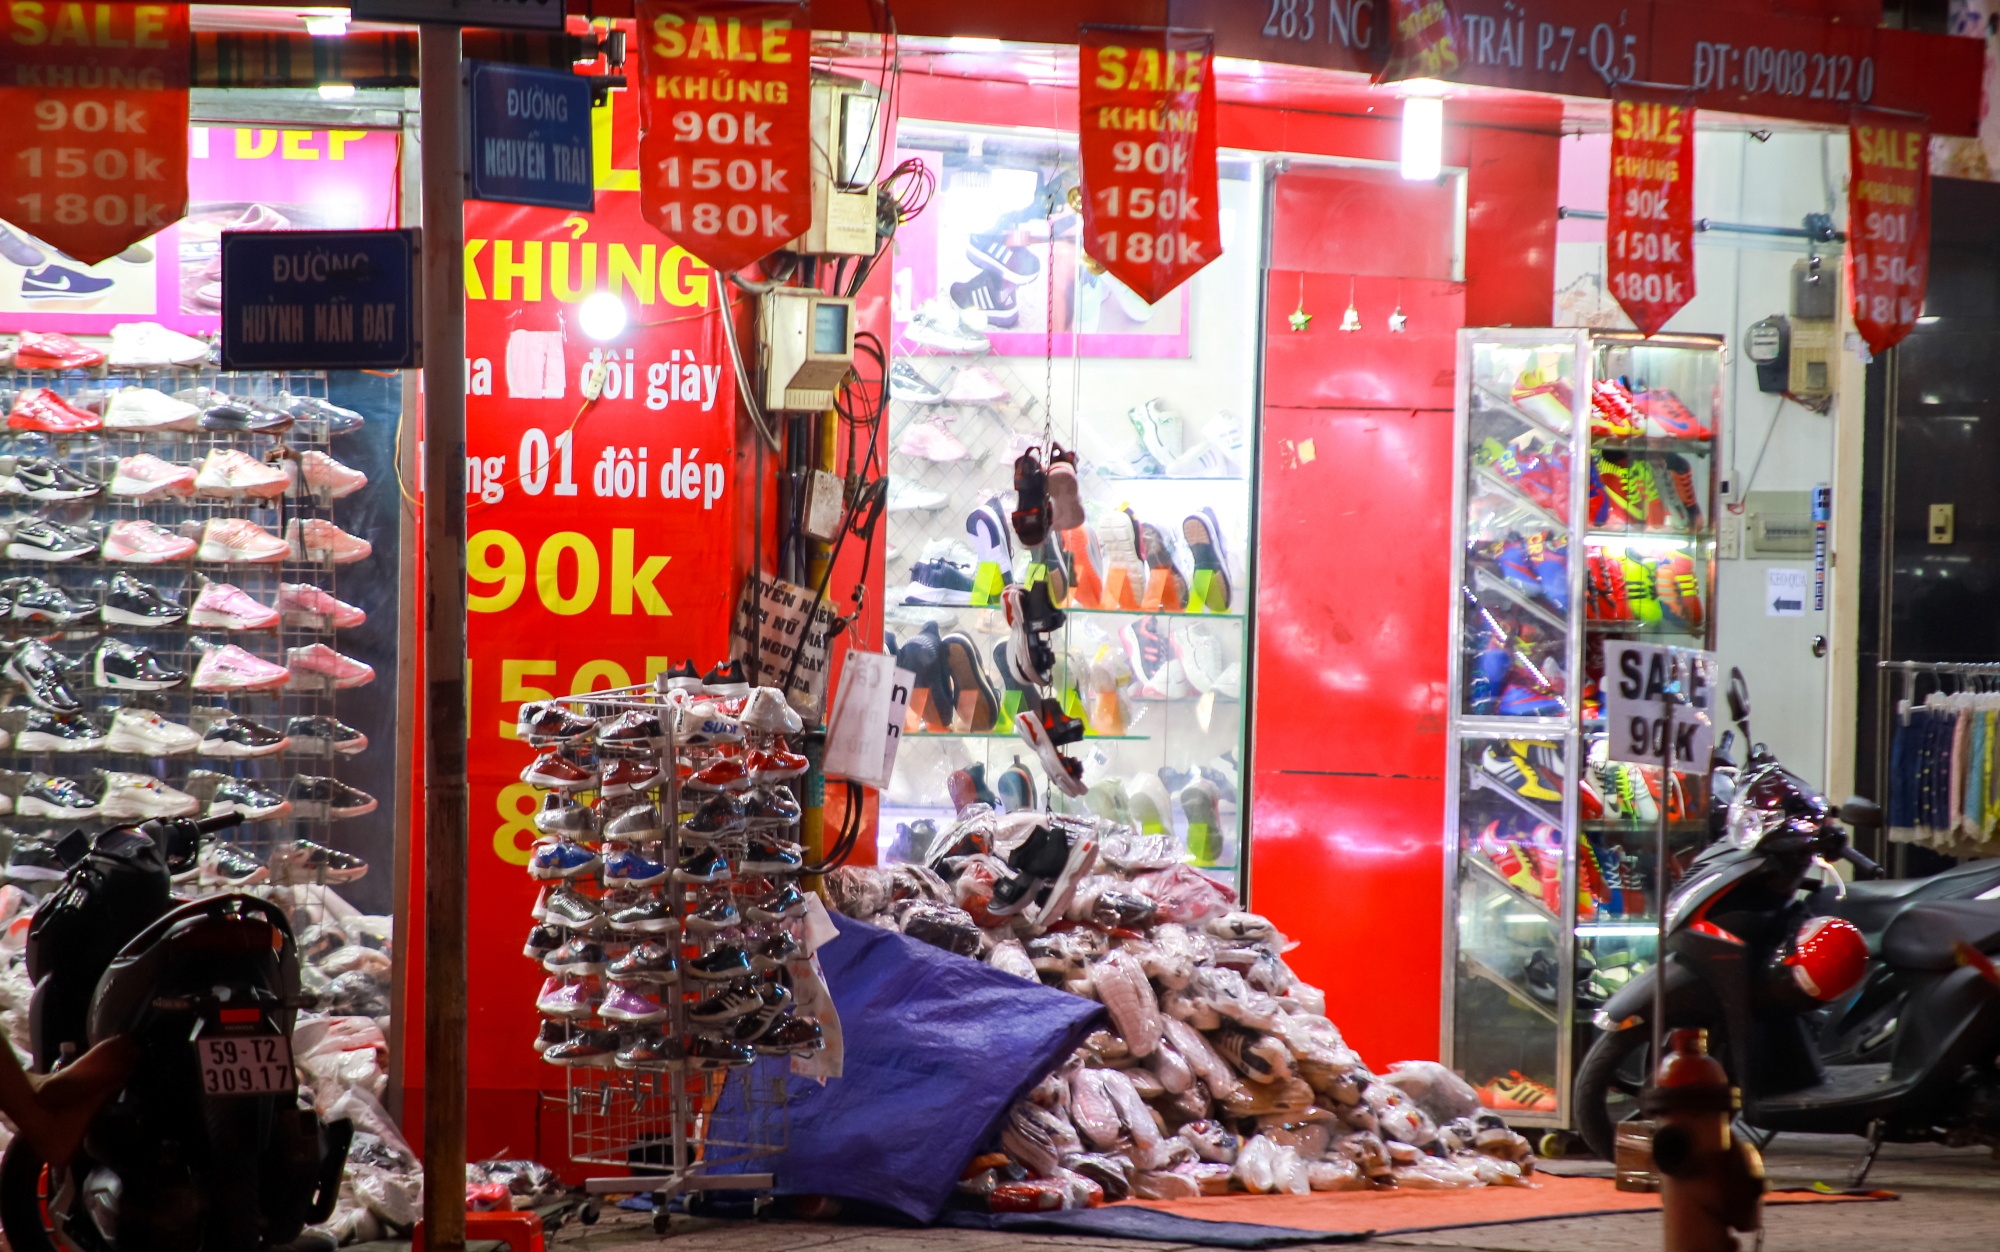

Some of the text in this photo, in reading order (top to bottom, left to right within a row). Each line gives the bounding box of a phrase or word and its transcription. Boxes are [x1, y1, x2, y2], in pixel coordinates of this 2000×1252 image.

[10, 1, 169, 49] SALE
[1263, 0, 1315, 41] 283
[653, 13, 792, 64] SALE
[16, 57, 164, 91] KHỦNG
[1095, 45, 1203, 92] SALE
[507, 83, 568, 122] ĐƯỜNG
[656, 69, 788, 104] KHỦNG
[34, 99, 147, 134] 90k
[672, 111, 773, 146] 90k
[1098, 99, 1198, 132] KHỦNG
[1615, 101, 1682, 144] SALE
[17, 147, 166, 181] 150k
[485, 129, 545, 180] NGUYỄN
[1112, 141, 1188, 174] 90k
[1858, 126, 1921, 170] SALE
[657, 157, 789, 193] 150k
[16, 193, 167, 226] 180k
[660, 201, 792, 238] 180k
[1096, 186, 1202, 221] 150k
[1624, 188, 1669, 220] 90k
[1097, 231, 1206, 264] 180k
[1615, 230, 1683, 262] 150k
[1614, 272, 1683, 303] 180k
[242, 295, 395, 348] HUỲNH MẪN ĐẠT
[581, 347, 634, 400] đôi
[646, 349, 721, 411] giày
[519, 427, 577, 496] 01
[594, 446, 648, 498] đôi
[660, 447, 725, 509] dép
[1500, 450, 1521, 476] CR7
[1528, 534, 1545, 562] CR7
[467, 528, 673, 616] 90k
[1619, 649, 1708, 708] SALE
[1630, 716, 1700, 762] 90K
[209, 1038, 279, 1065] 59-T2
[206, 1065, 288, 1092] 309.17
